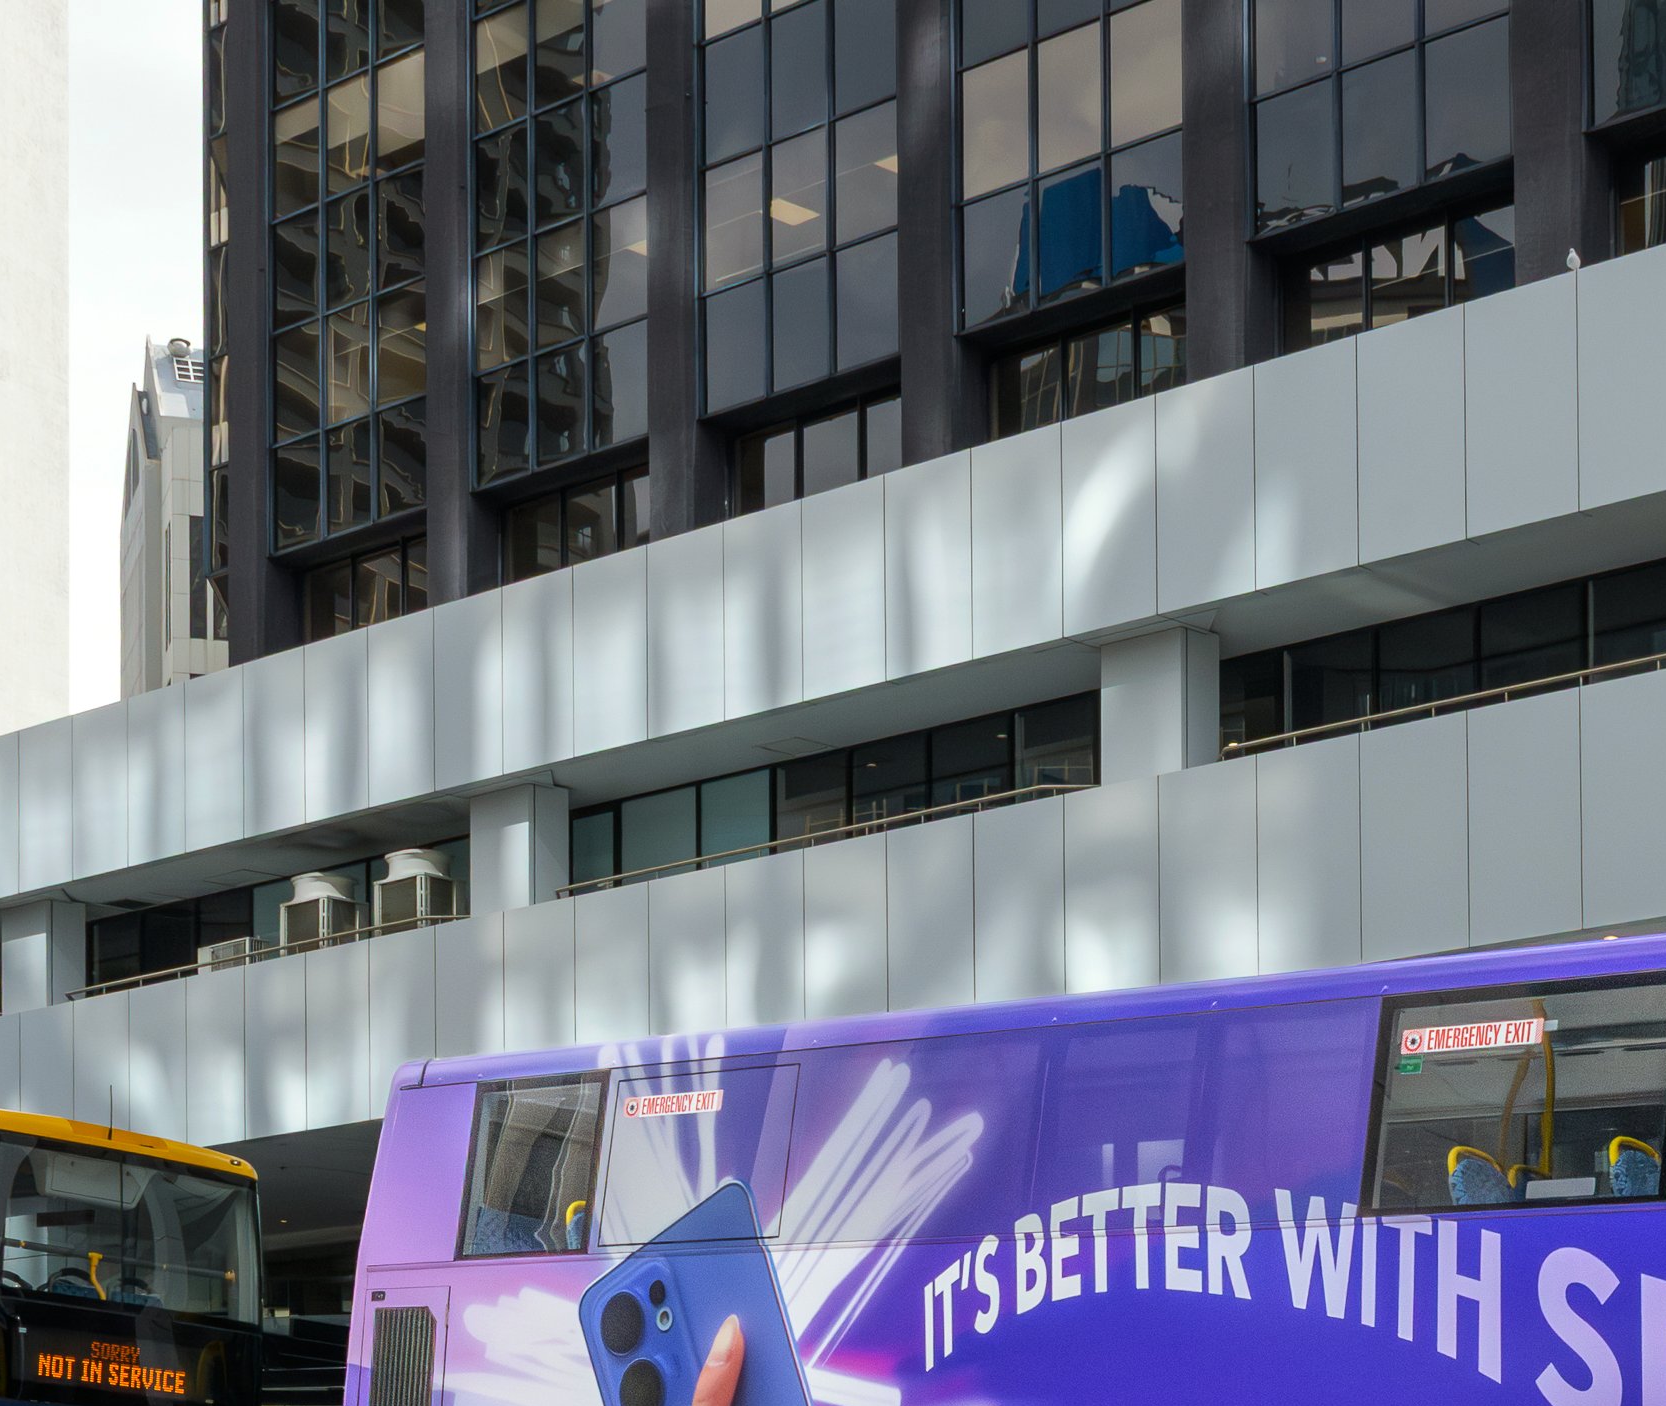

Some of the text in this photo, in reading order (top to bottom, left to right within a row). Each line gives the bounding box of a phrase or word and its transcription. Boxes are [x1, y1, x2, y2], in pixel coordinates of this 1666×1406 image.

[1427, 1021, 1533, 1050] EMERGENCY EXIT
[641, 1091, 716, 1115] EMERGENCY EXIT
[924, 1235, 1000, 1373] IT'S
[1013, 1182, 1253, 1317] BETTER
[1274, 1188, 1502, 1384] WITH
[90, 1340, 141, 1364] SORRY
[37, 1352, 187, 1395] NOT IN SERVICE
